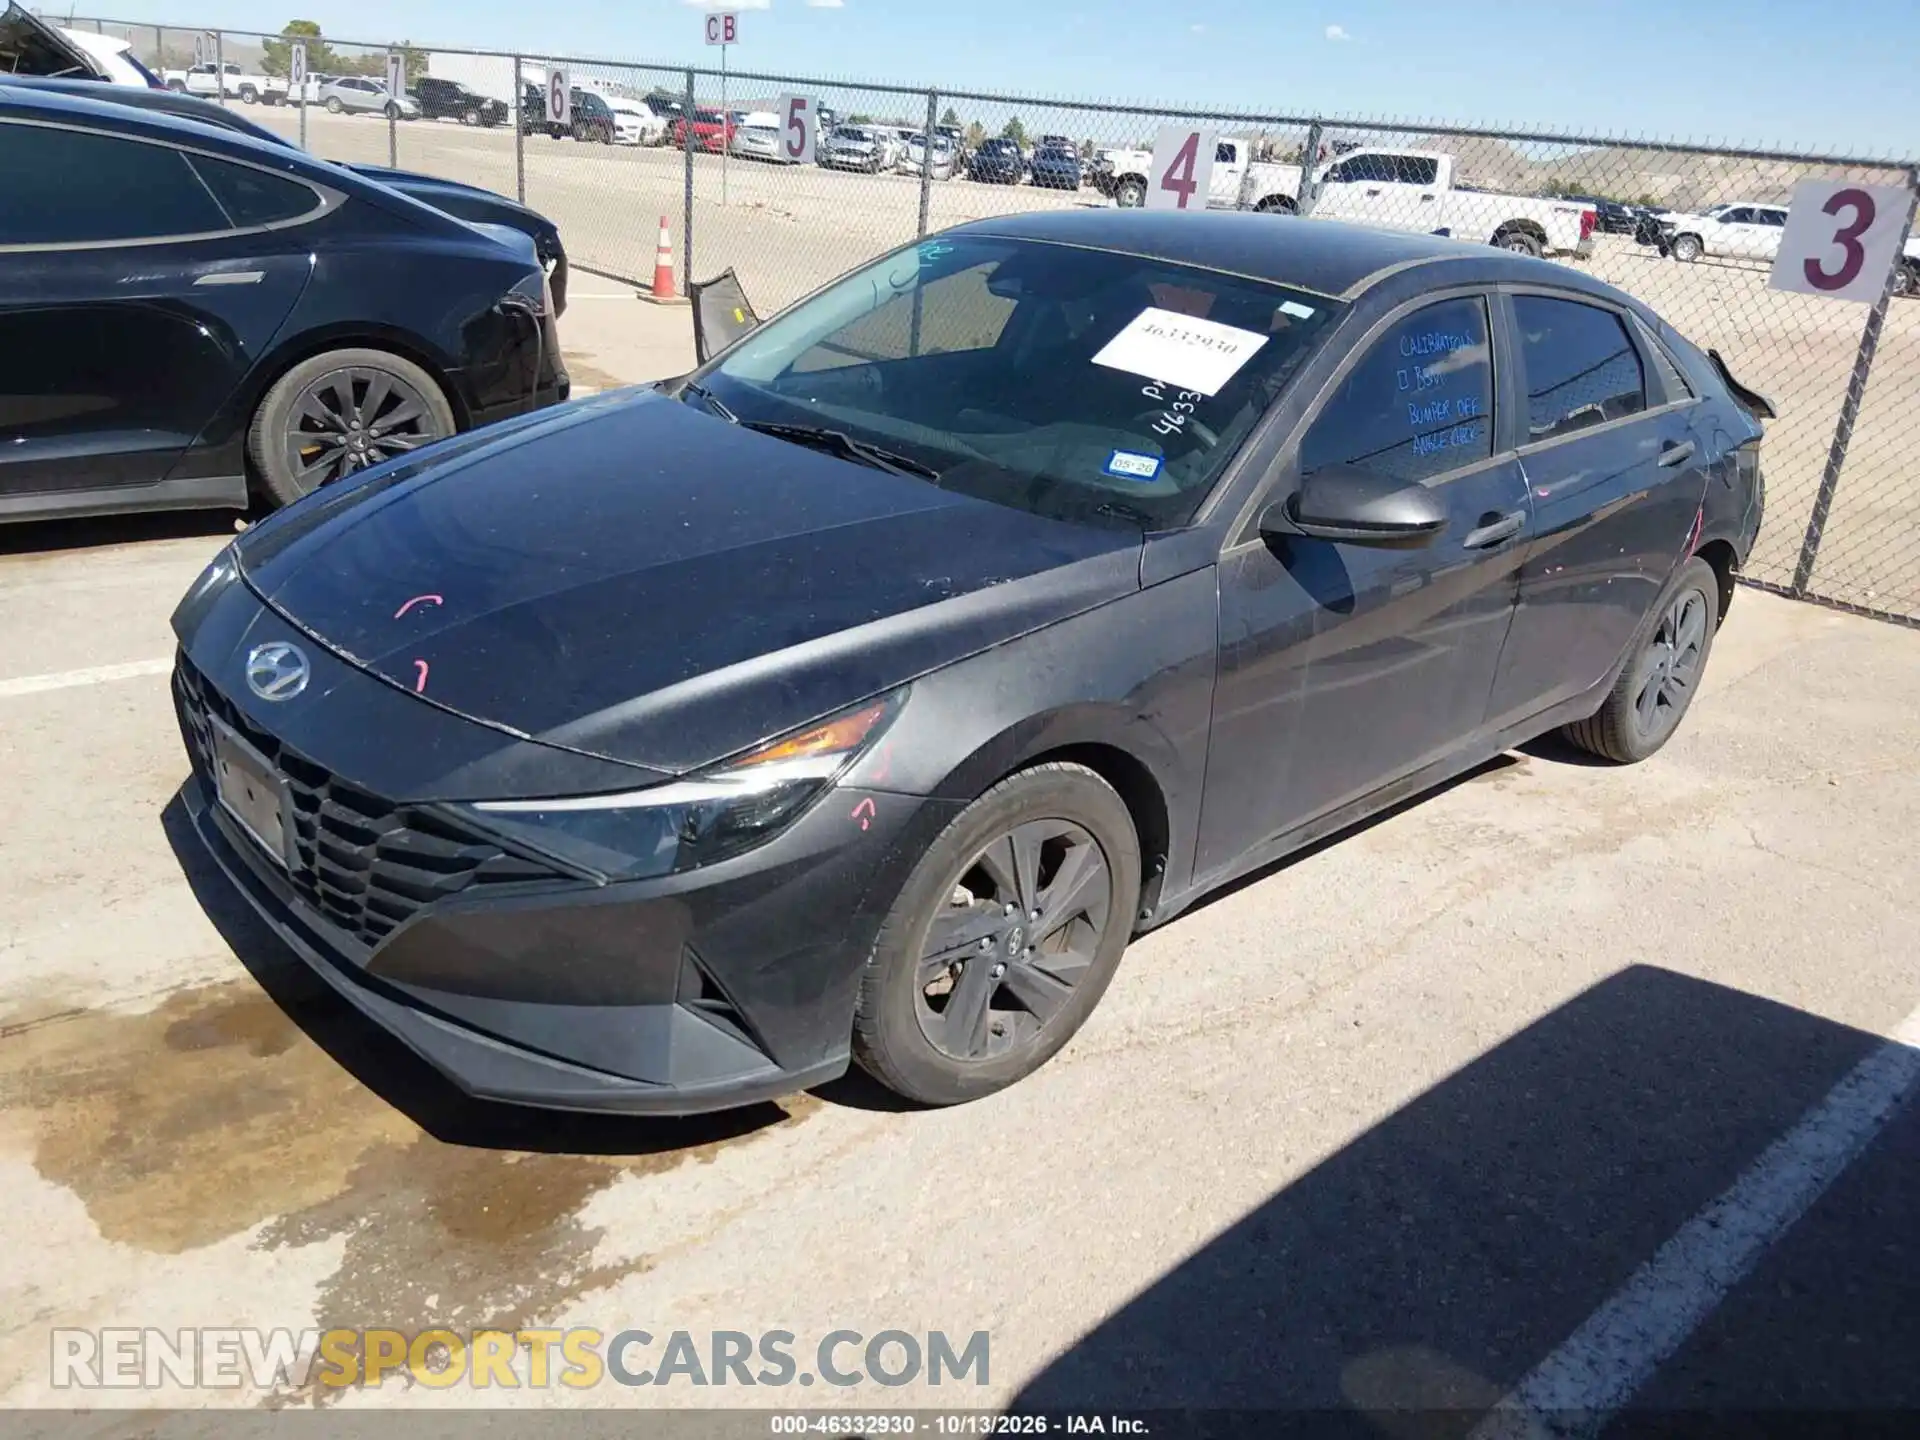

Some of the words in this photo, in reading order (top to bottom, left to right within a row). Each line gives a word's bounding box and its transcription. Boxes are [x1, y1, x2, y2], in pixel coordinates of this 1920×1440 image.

[390, 56, 401, 97] 7
[550, 71, 565, 120] 6
[786, 98, 808, 157] 5
[1160, 131, 1201, 209] 4
[1803, 188, 1877, 291] 3
